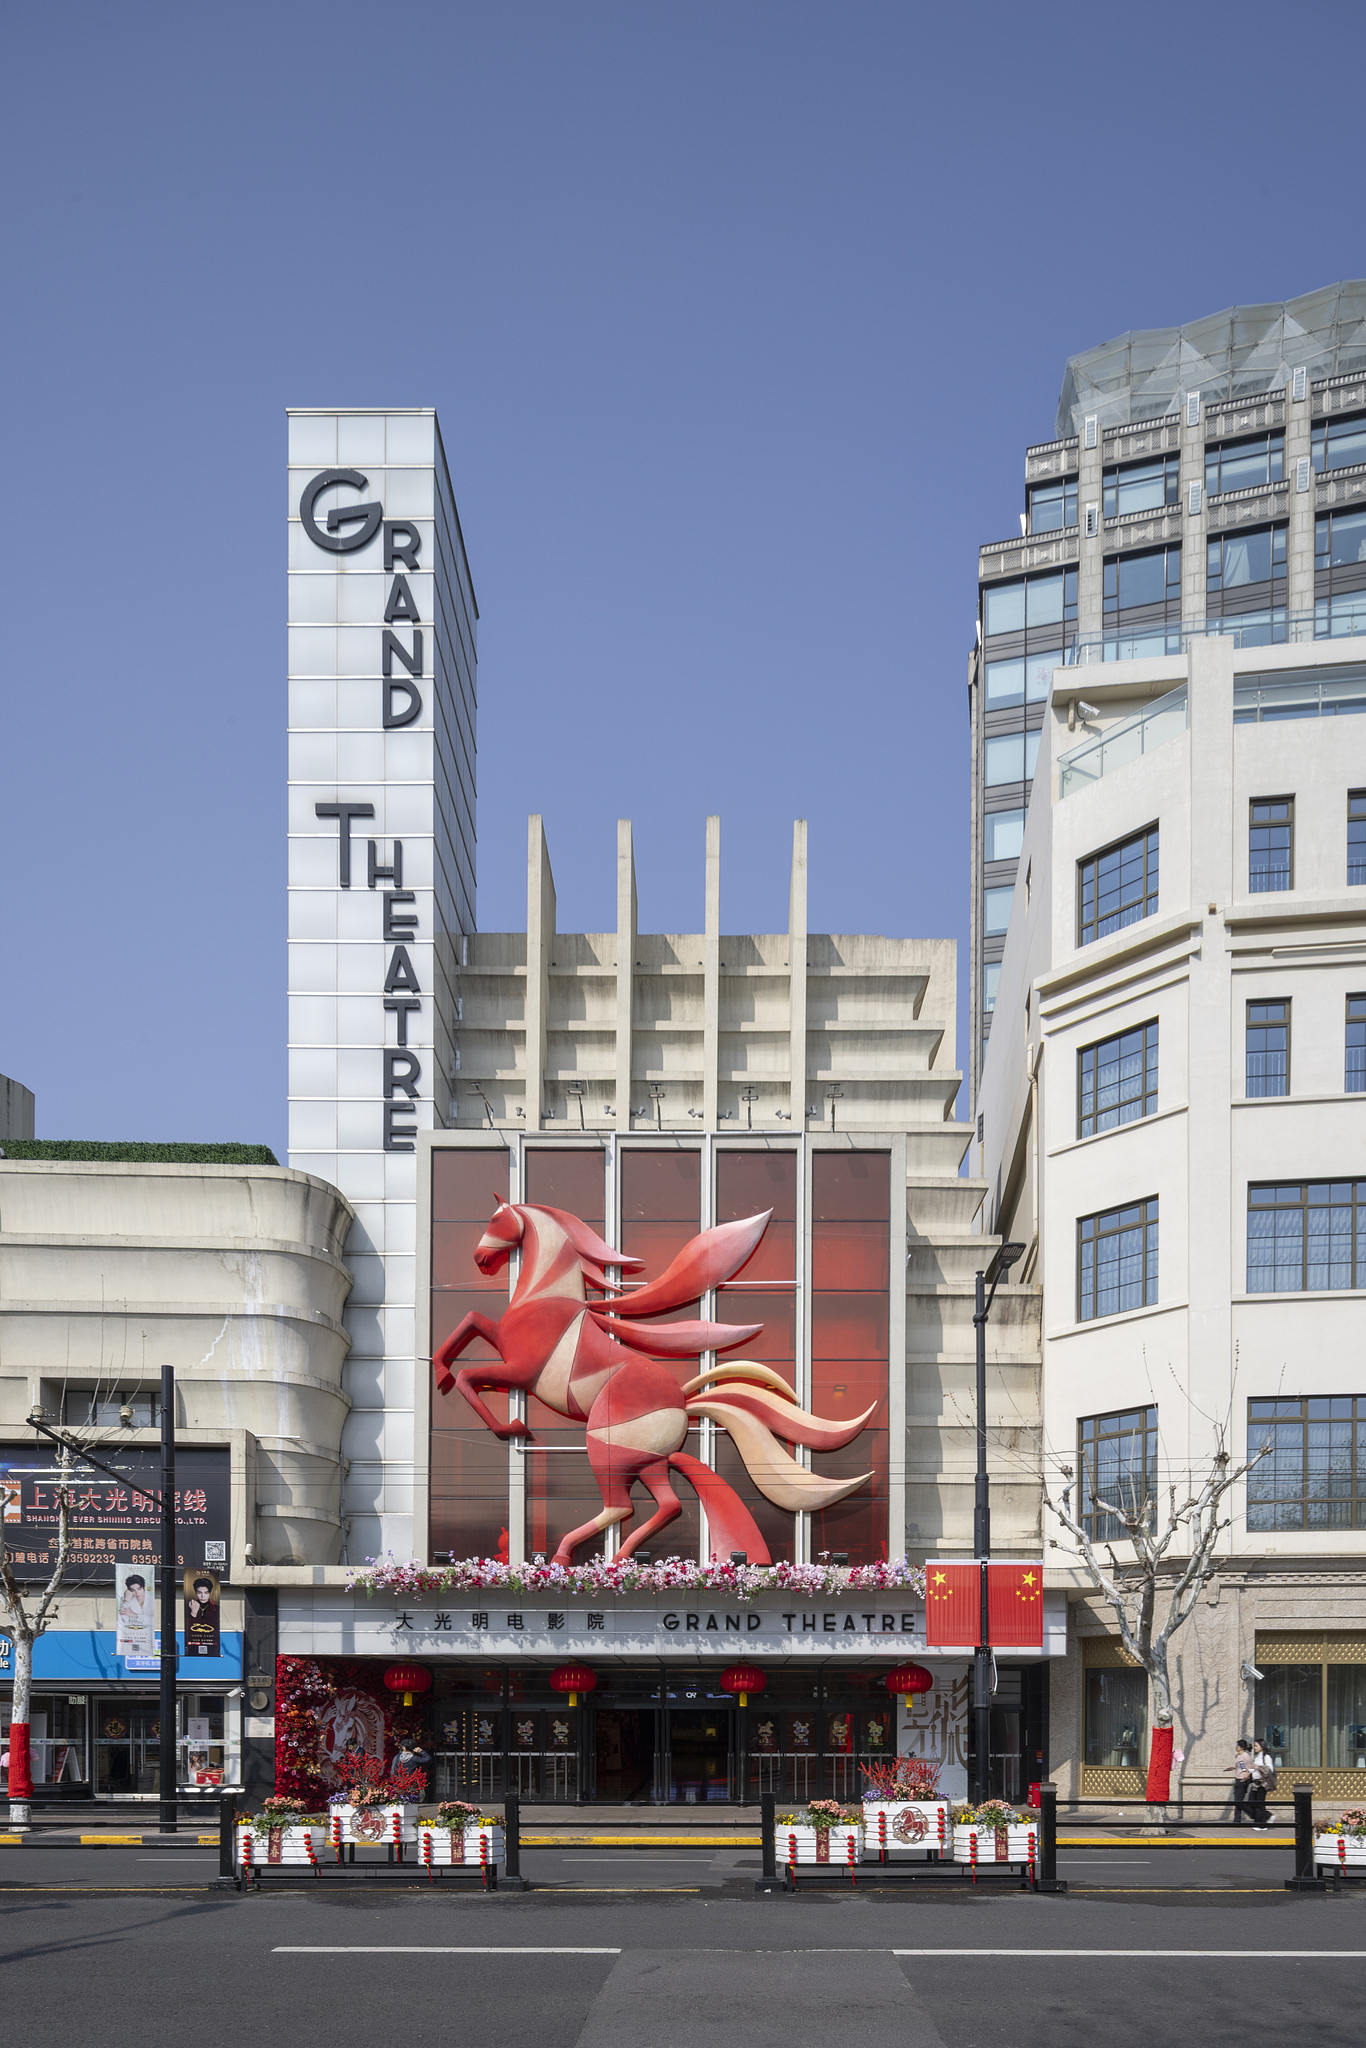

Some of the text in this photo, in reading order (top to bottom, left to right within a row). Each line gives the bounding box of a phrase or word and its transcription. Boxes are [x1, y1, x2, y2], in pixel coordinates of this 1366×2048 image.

[299, 468, 423, 1152] GRAND THEATRE
[72, 1515, 95, 1523] EVER
[97, 1516, 132, 1524] SHINING
[134, 1516, 161, 1524] CIRCU
[48, 1537, 153, 1550] 全首批跨省市院线
[395, 1612, 605, 1630] 大光明电影院
[662, 1613, 916, 1632] GRAND THEATRE
